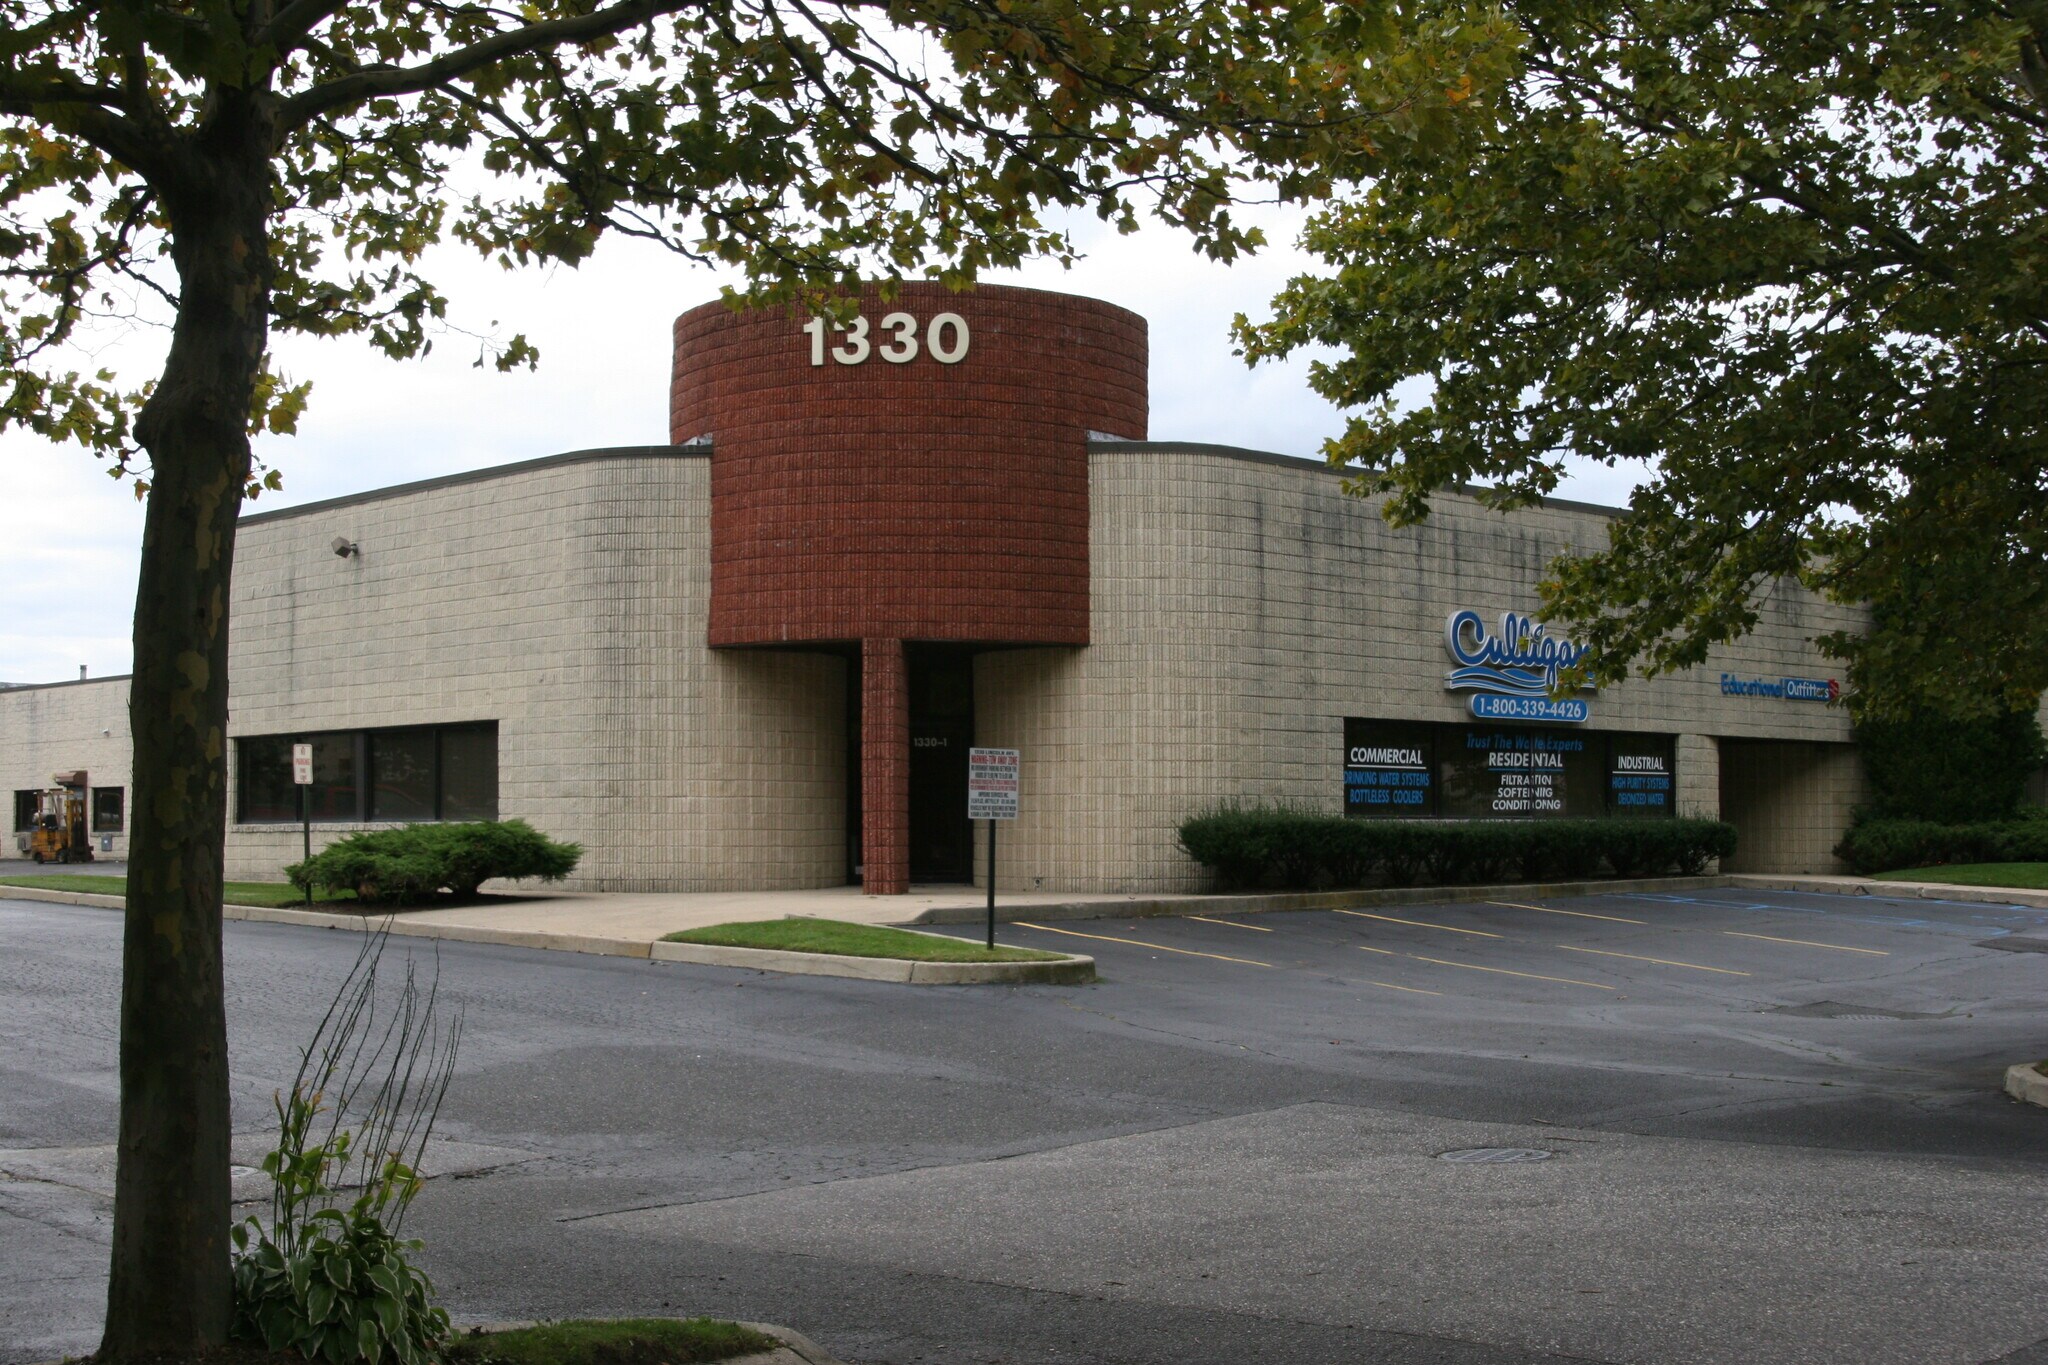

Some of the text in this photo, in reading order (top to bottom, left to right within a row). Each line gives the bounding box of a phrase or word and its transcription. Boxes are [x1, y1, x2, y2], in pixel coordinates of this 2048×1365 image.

[803, 312, 970, 366] 1330
[1720, 673, 1784, 698] Educational
[1480, 698, 1581, 718] 1-800-339-4426
[914, 737, 947, 747] 1330-1
[1467, 733, 1584, 751] Trust The Wate Experts
[1350, 747, 1423, 764] COMMERCIAL
[1618, 756, 1664, 770] INDUSTRIAL
[1343, 771, 1430, 786] DRINKING WATER SYSTEMS
[1612, 777, 1670, 790] HIGH PURITY SYSTEMS
[1350, 789, 1424, 804] BOTTLELESS COOLERS
[1648, 793, 1665, 805] WATER
